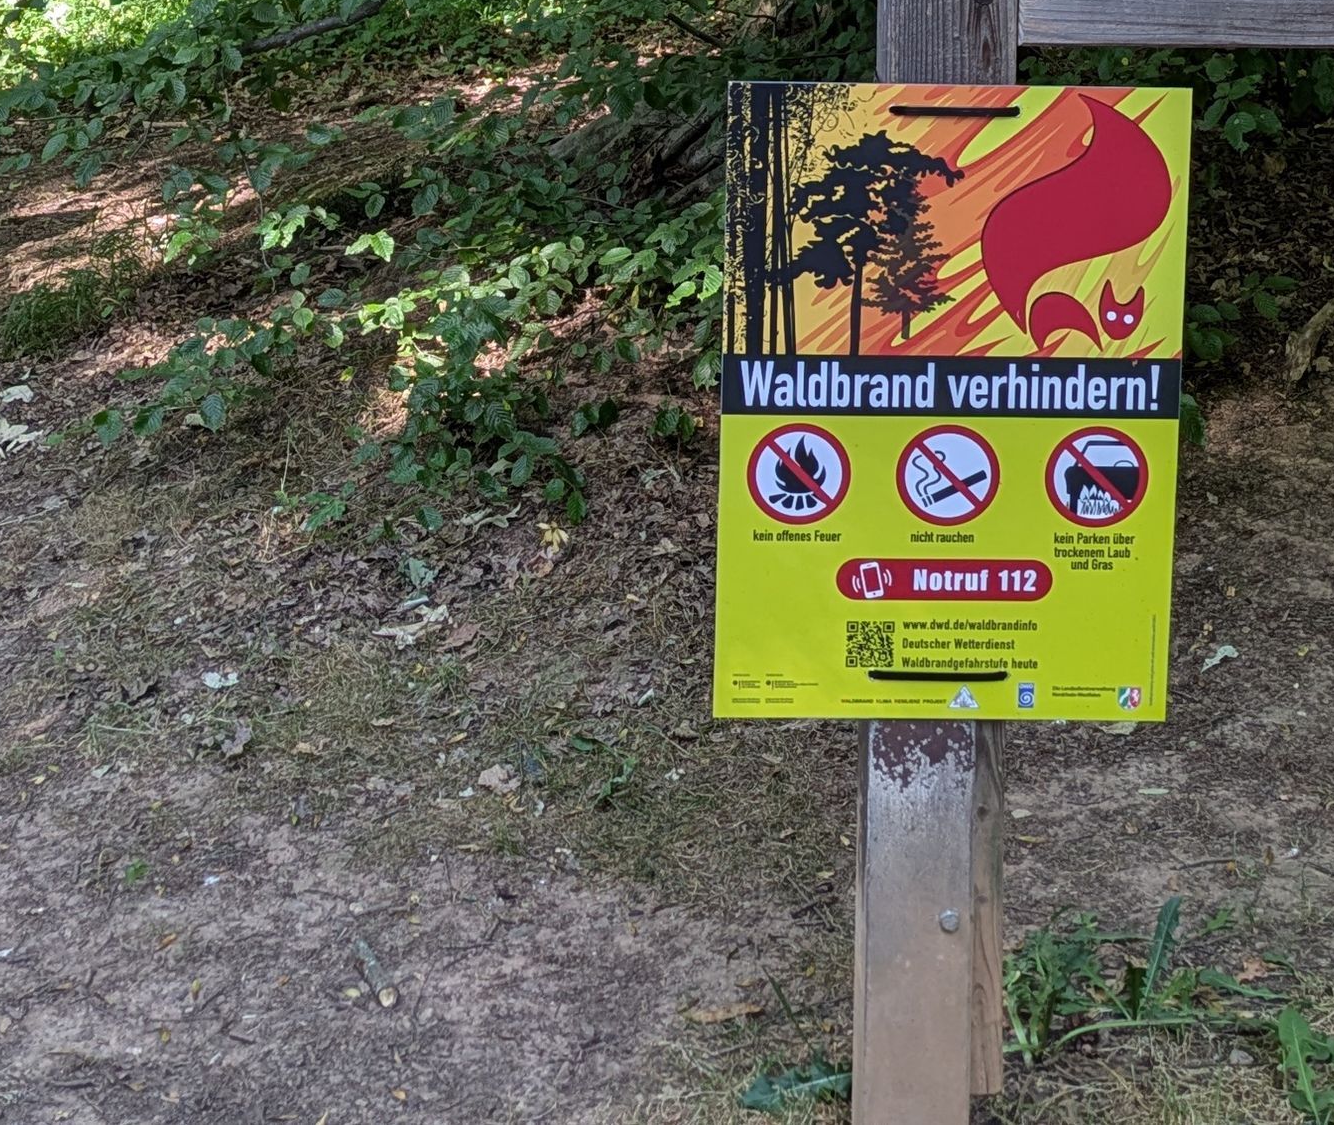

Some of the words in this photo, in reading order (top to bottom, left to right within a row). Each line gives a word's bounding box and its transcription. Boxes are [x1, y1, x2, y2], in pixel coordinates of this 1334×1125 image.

[740, 359, 936, 409] Waldbrand
[947, 363, 1160, 412] verhindern!
[753, 530, 773, 542] kein
[776, 530, 811, 542] offenes
[814, 530, 842, 542] Feuer
[910, 531, 934, 543] nicht
[935, 532, 974, 543] rauchen
[1054, 532, 1074, 544] kein
[1076, 533, 1110, 544] Parken
[1113, 533, 1135, 545] über
[1054, 547, 1105, 558] trockenem
[1107, 547, 1131, 559] Laub
[1070, 559, 1088, 570] und
[1091, 559, 1113, 571] Gras
[913, 568, 989, 593] Notruf
[998, 569, 1037, 592] 112
[902, 618, 1038, 633] www.dwd.de/waldbrandinfo
[901, 637, 950, 650] Deutscher
[953, 638, 1015, 650] Wetterdienst
[901, 656, 1009, 671] Waldbrandgefahrstufe
[1011, 657, 1038, 670] heute
